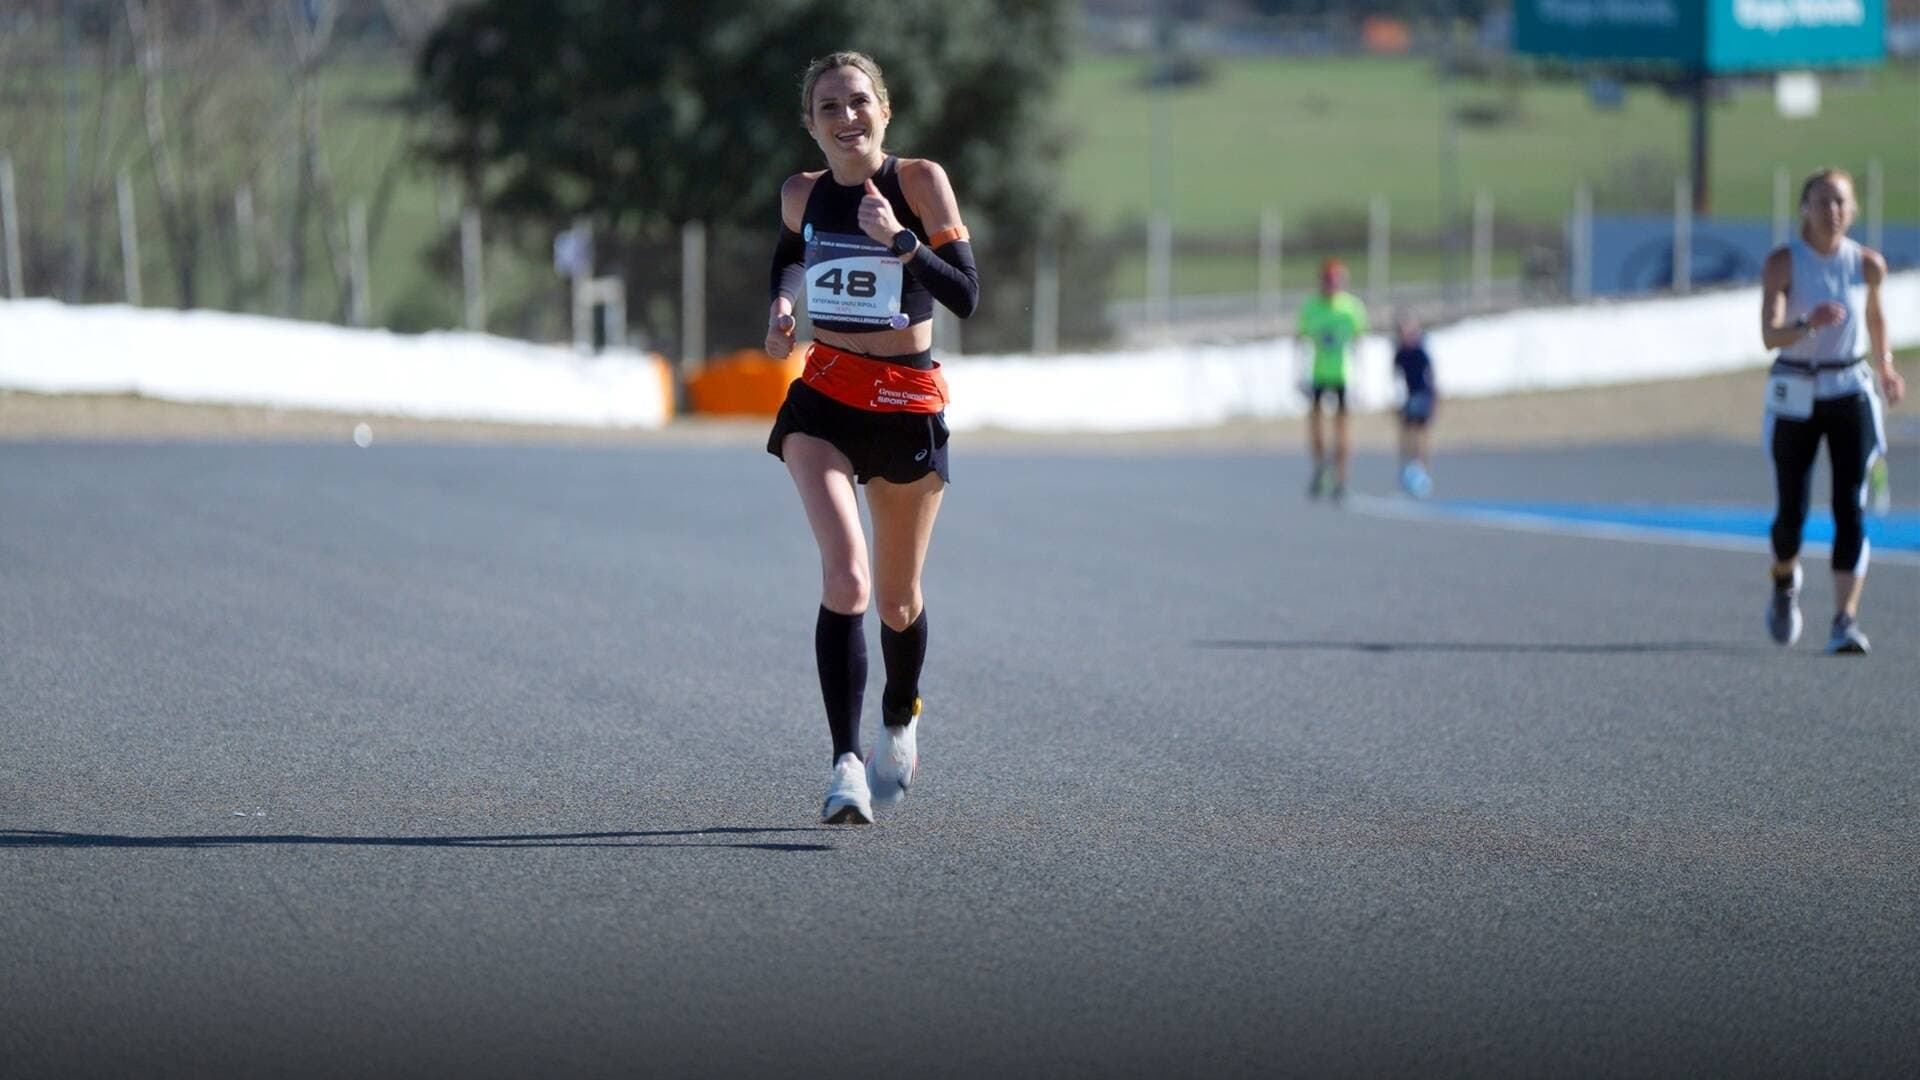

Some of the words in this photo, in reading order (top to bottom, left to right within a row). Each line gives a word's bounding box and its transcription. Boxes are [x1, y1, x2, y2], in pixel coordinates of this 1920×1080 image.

[815, 268, 877, 298] 48
[878, 388, 902, 398] Green
[877, 396, 909, 406] SPORT
